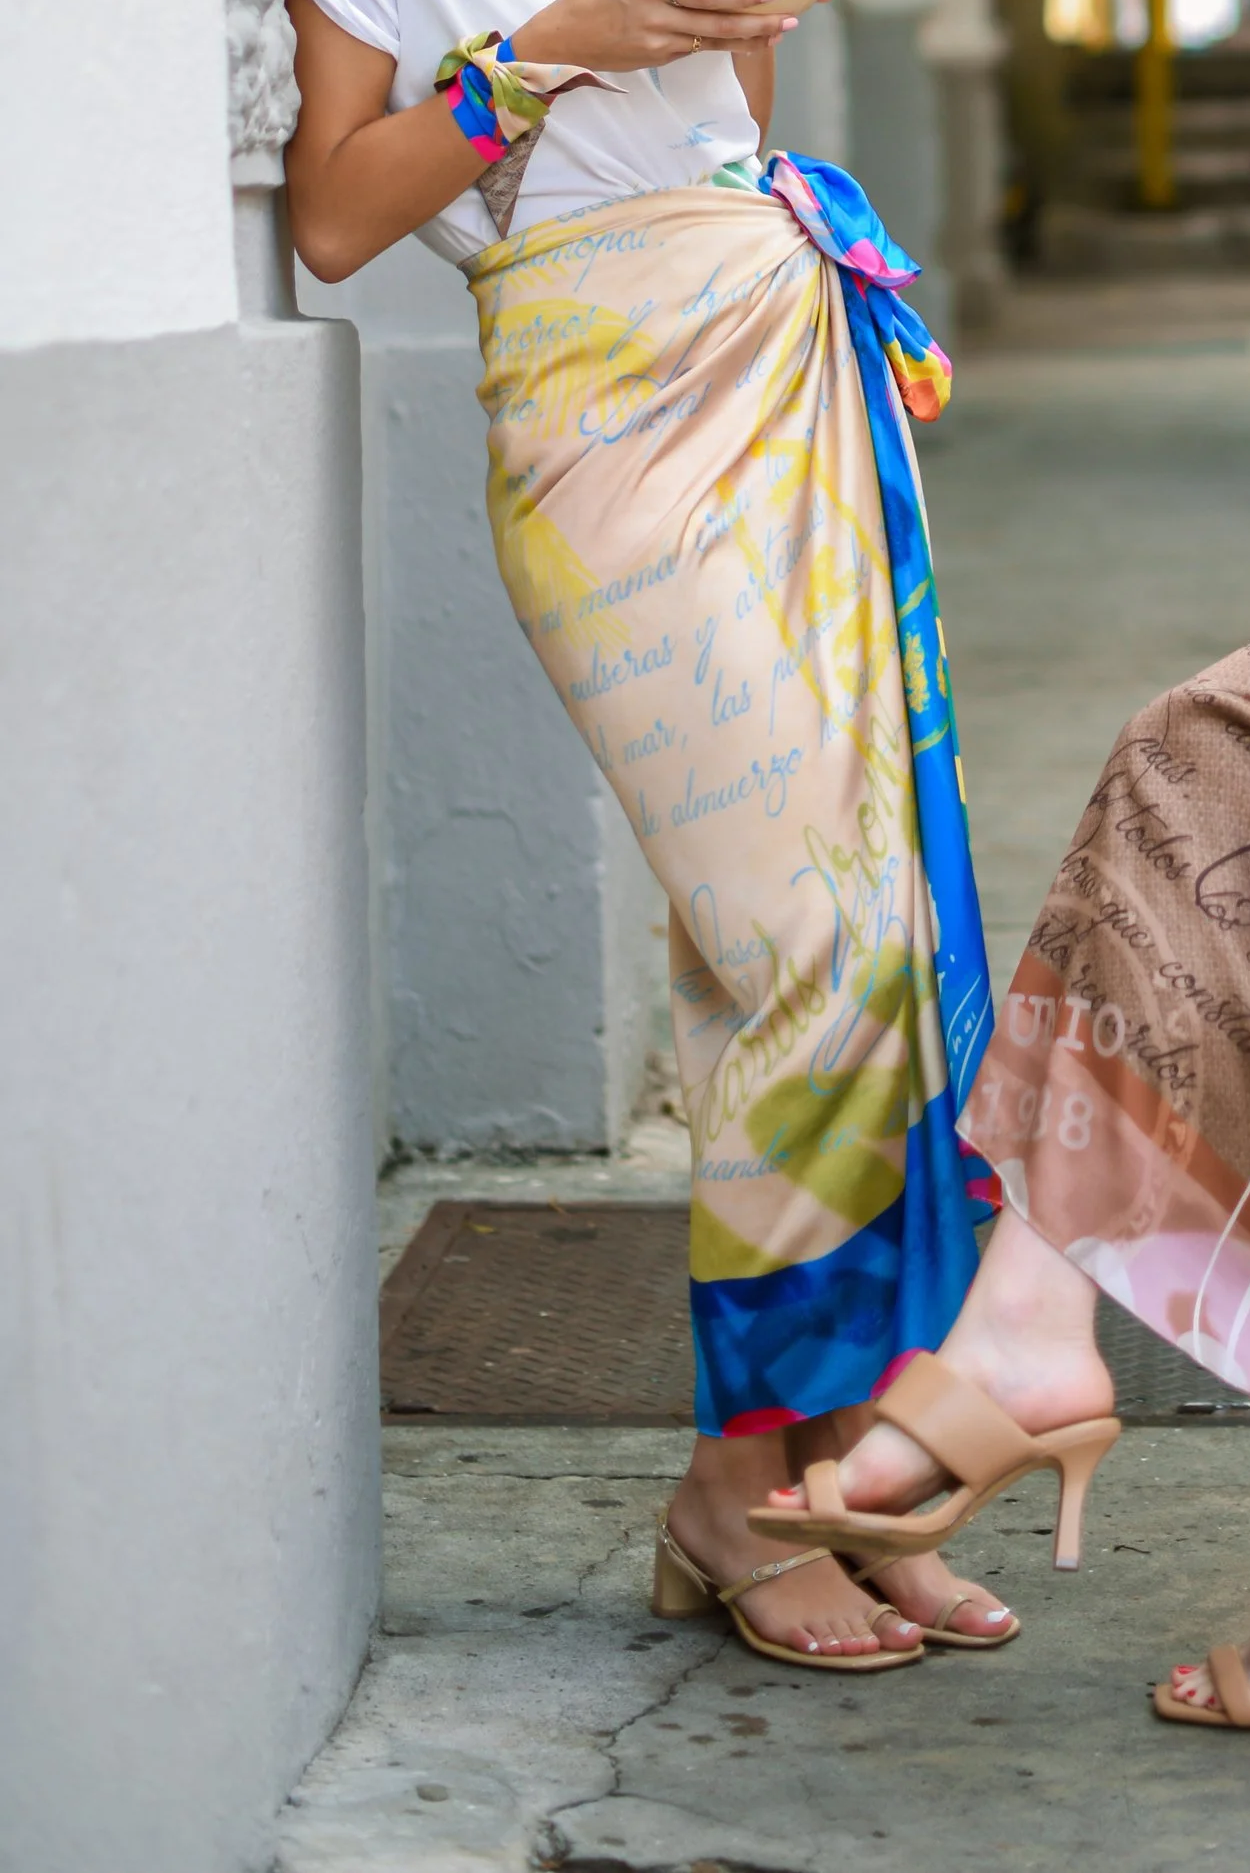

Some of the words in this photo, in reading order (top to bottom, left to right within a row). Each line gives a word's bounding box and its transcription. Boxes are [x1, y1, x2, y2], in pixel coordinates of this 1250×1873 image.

[577, 544, 683, 623] mamá
[712, 667, 753, 727] las
[670, 744, 805, 819] almuerzo
[1114, 802, 1195, 882] todos
[1082, 897, 1156, 951] que
